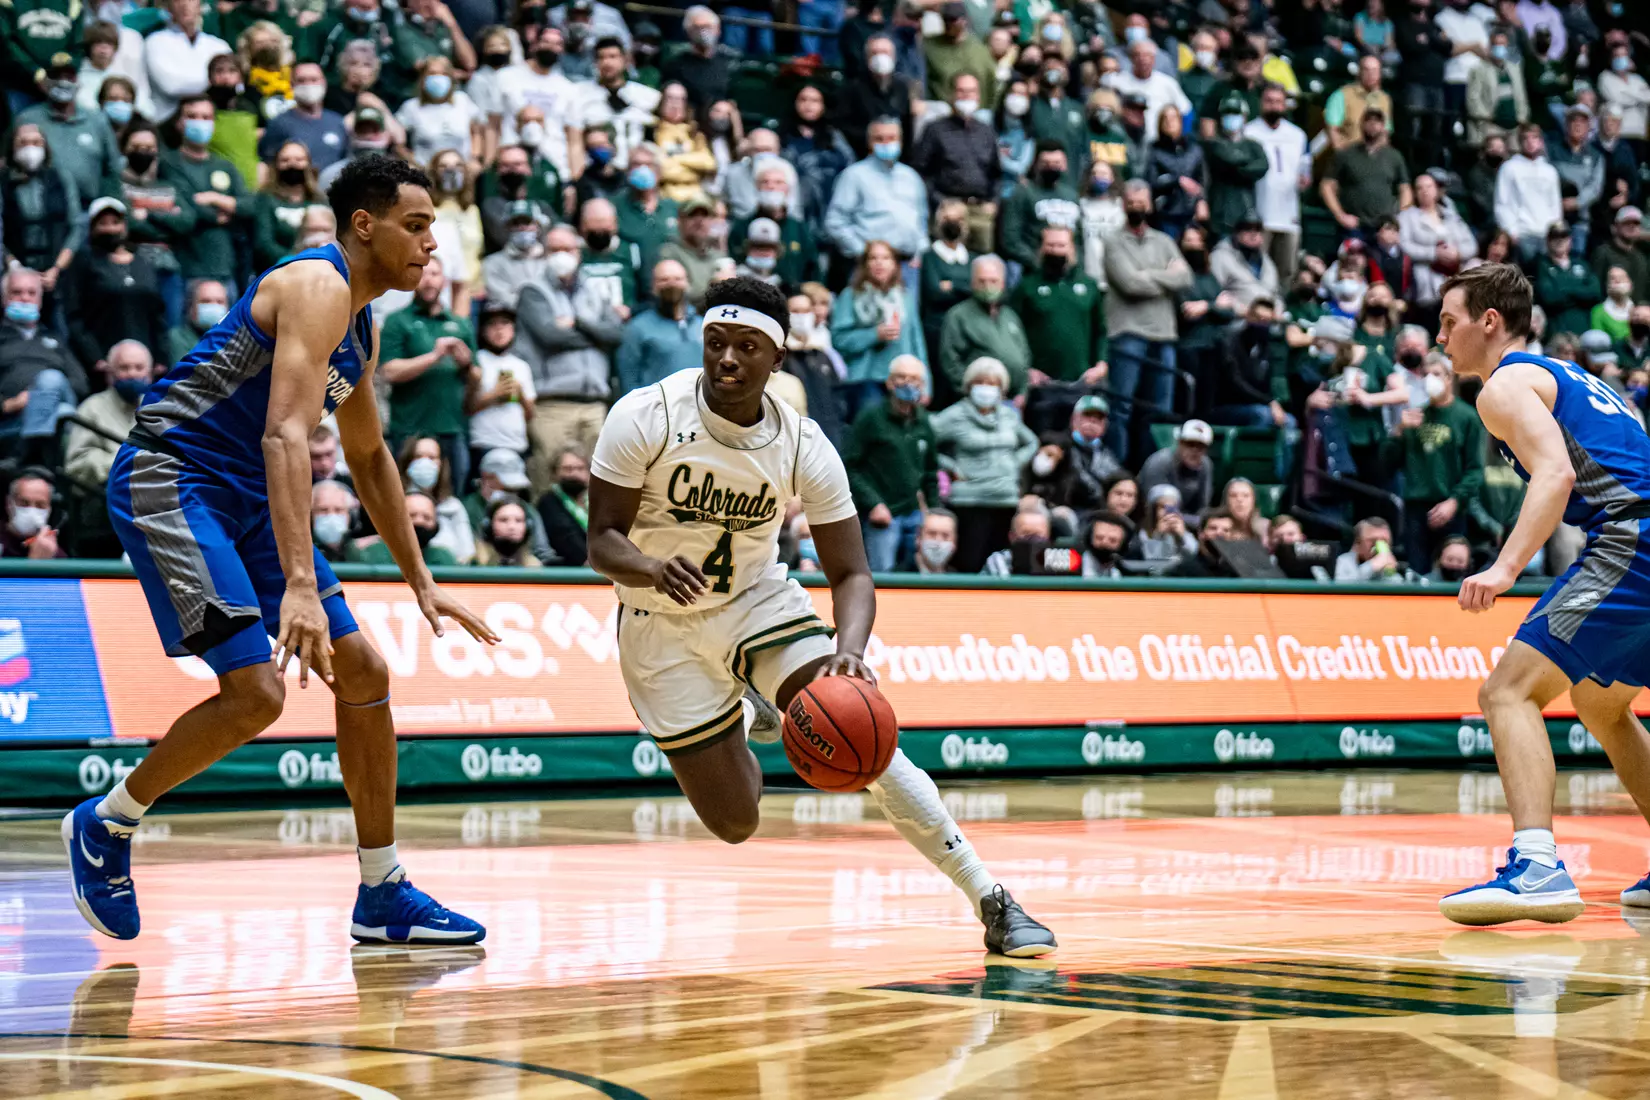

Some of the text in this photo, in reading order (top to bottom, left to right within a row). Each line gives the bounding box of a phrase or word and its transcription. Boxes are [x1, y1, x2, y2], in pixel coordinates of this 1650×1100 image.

[667, 463, 777, 519] Colorado
[701, 530, 737, 594] 4
[1071, 633, 1139, 681] the
[1139, 633, 1279, 681] Official
[1276, 634, 1388, 681] Credit
[1382, 635, 1490, 680] Union
[789, 696, 836, 760] Wilson
